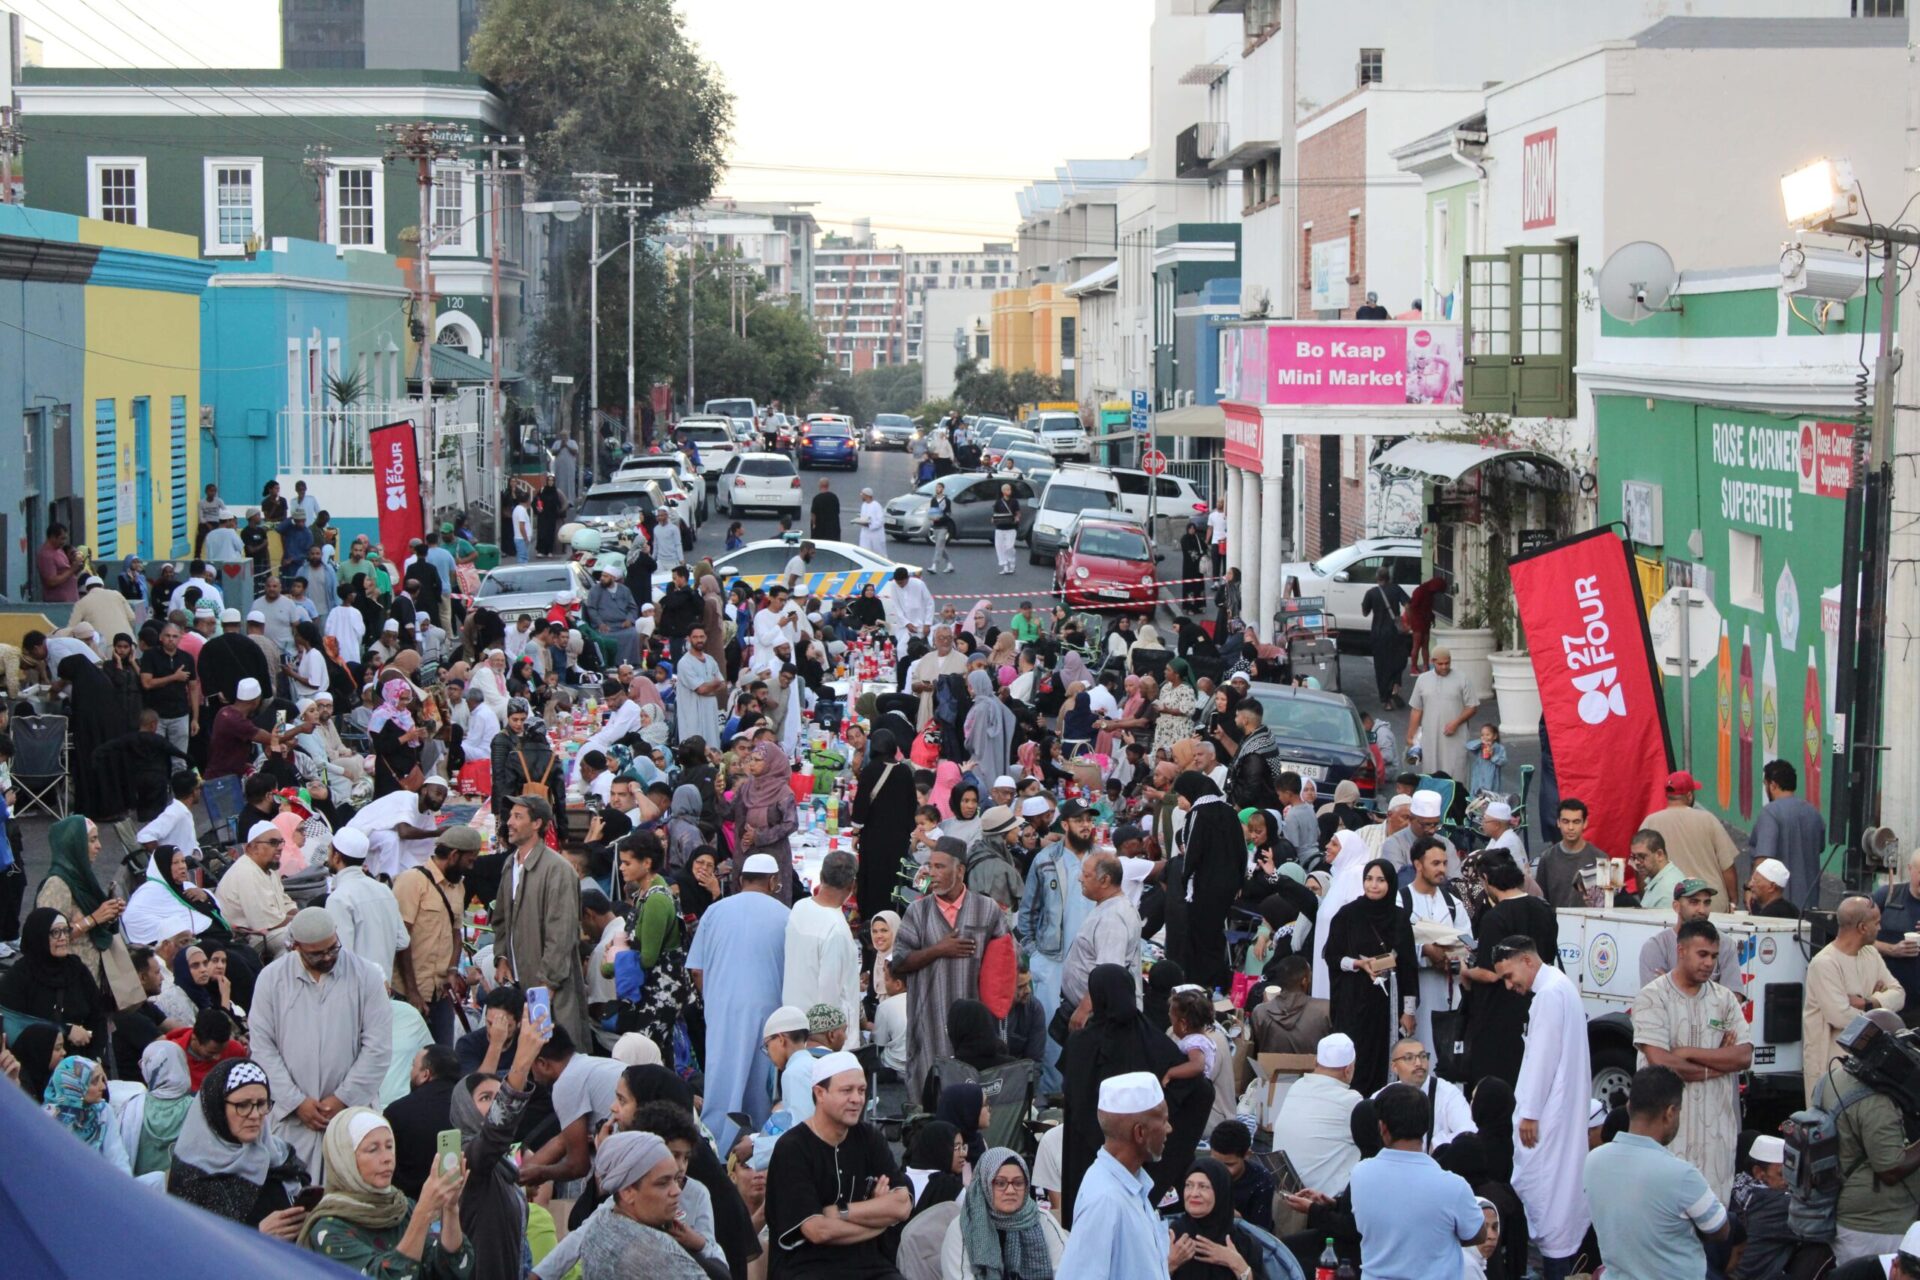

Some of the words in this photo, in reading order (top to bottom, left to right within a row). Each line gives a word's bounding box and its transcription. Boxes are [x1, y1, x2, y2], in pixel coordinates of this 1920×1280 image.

[446, 297, 464, 308] 120
[1296, 341, 1324, 358] Bo
[1331, 341, 1386, 361] Kaap
[1278, 369, 1321, 385] Mini
[1329, 369, 1404, 386] Market
[1135, 391, 1144, 405] P
[1713, 423, 1744, 467] ROSE
[1749, 426, 1799, 472] CORNER
[1817, 428, 1831, 455] Rose
[391, 442, 405, 483] FOUR
[1721, 477, 1793, 531] SUPERETTE
[1574, 574, 1615, 665] FOUR
[1561, 634, 1591, 670] 27
[1569, 949, 1580, 958] 29
